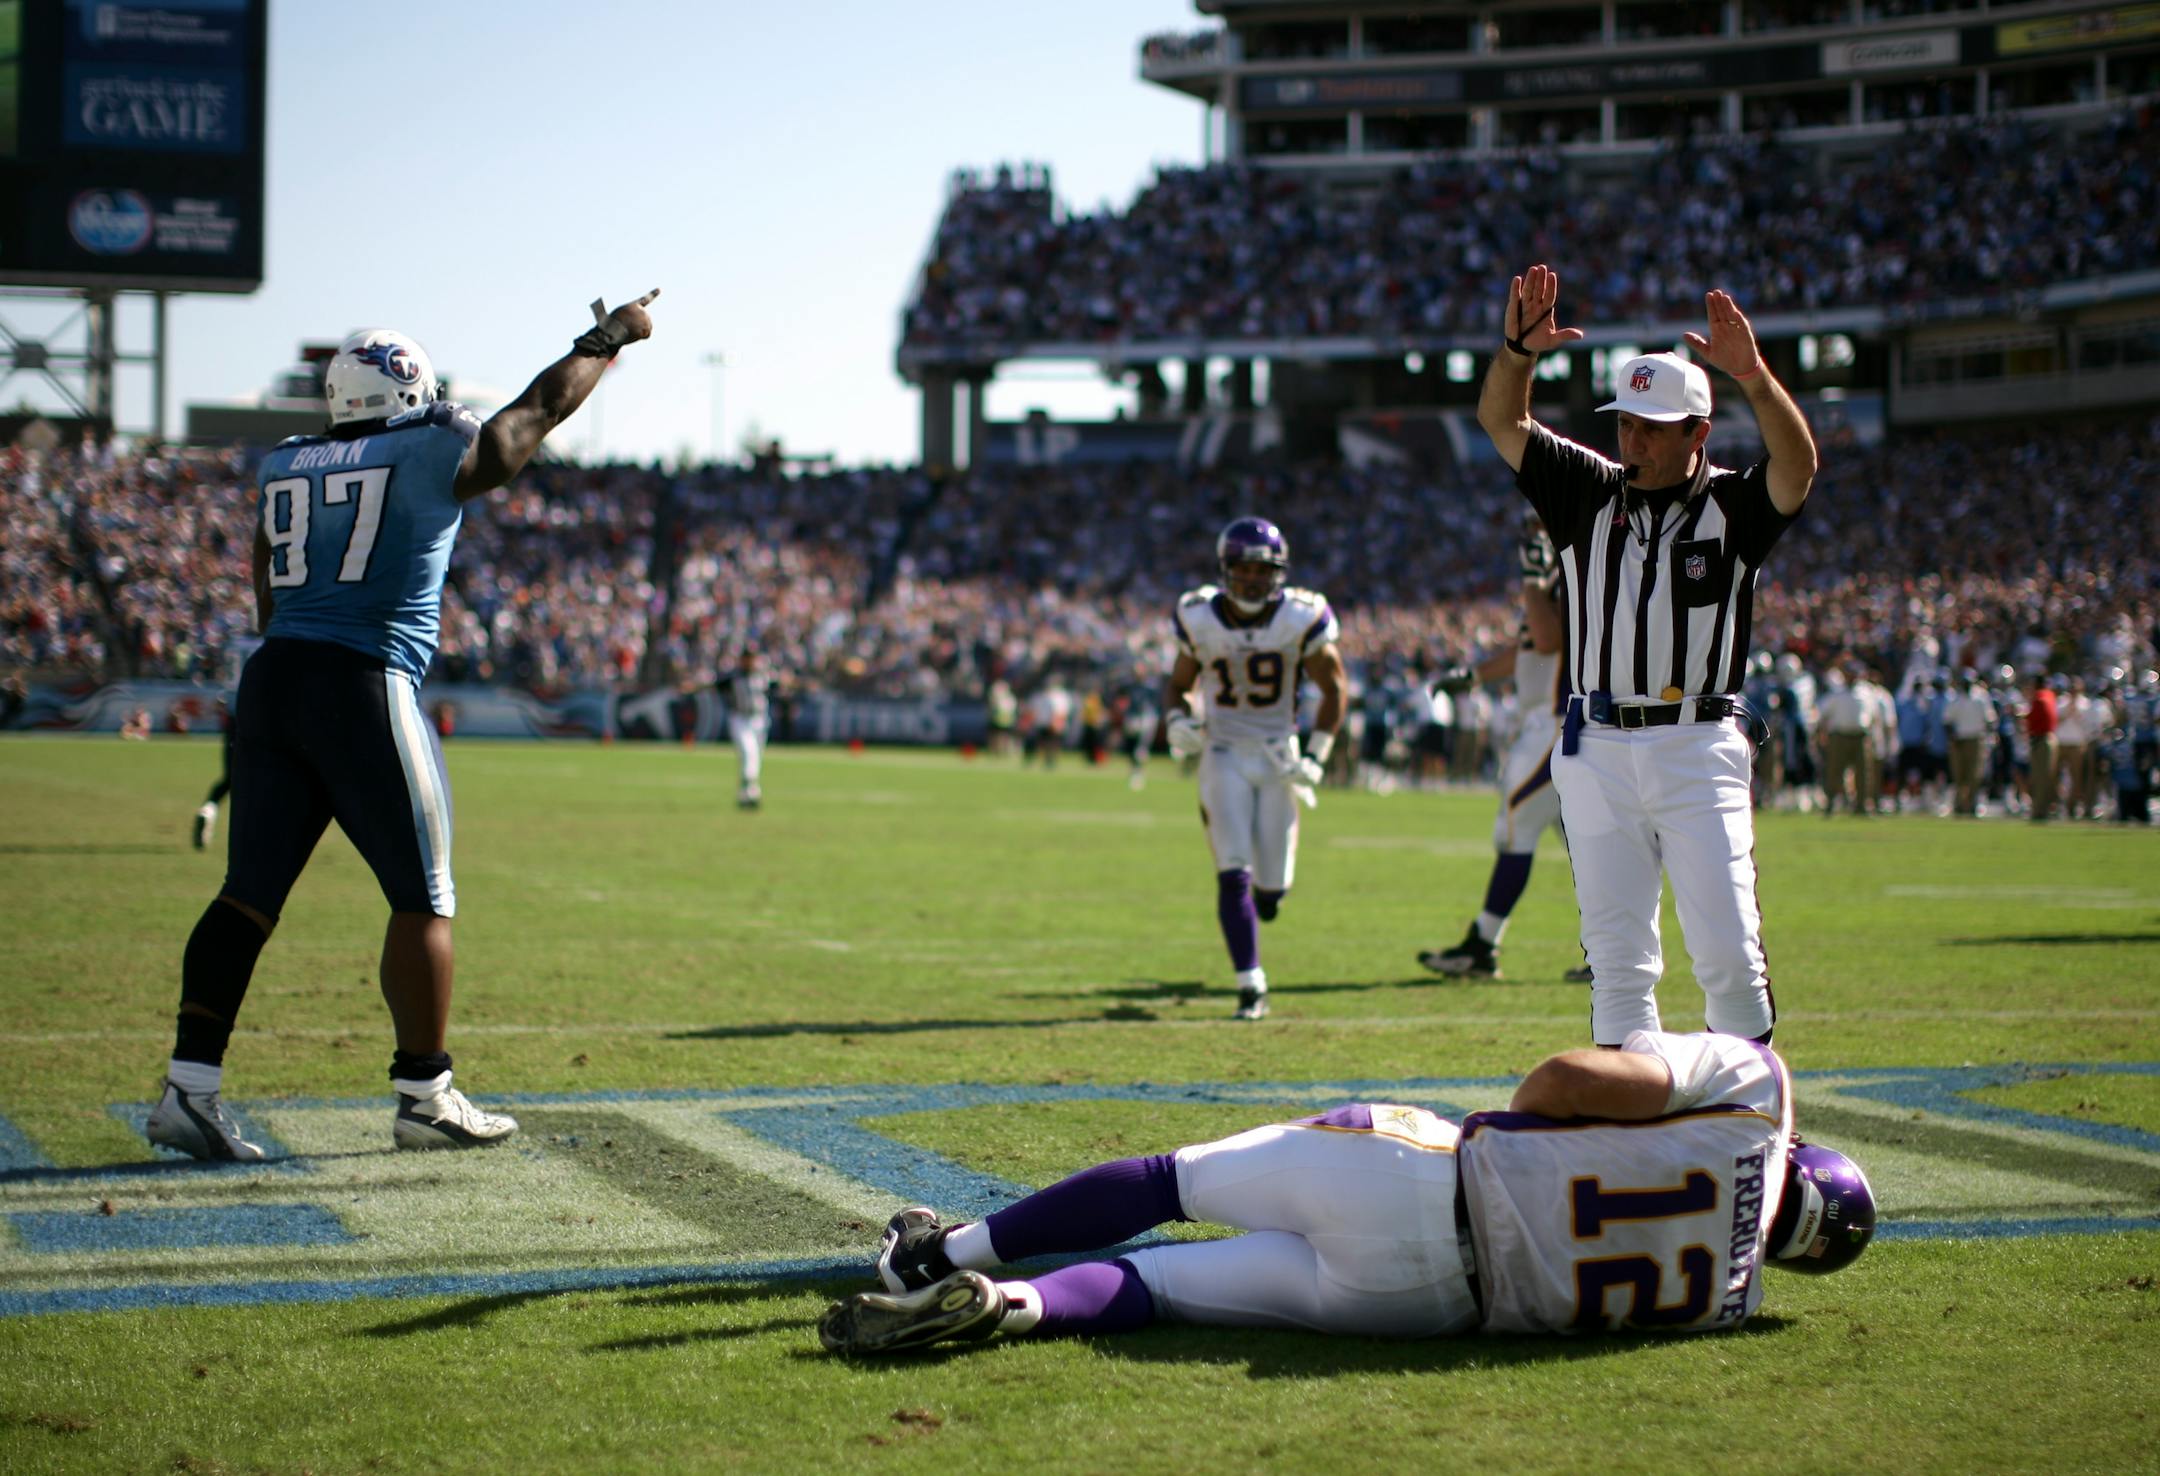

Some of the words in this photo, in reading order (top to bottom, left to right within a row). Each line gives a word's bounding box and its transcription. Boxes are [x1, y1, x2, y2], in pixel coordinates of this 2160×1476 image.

[289, 440, 370, 470] BROWN
[263, 466, 394, 589] 97
[1211, 651, 1285, 709] 19
[1572, 1171, 1718, 1333] 12
